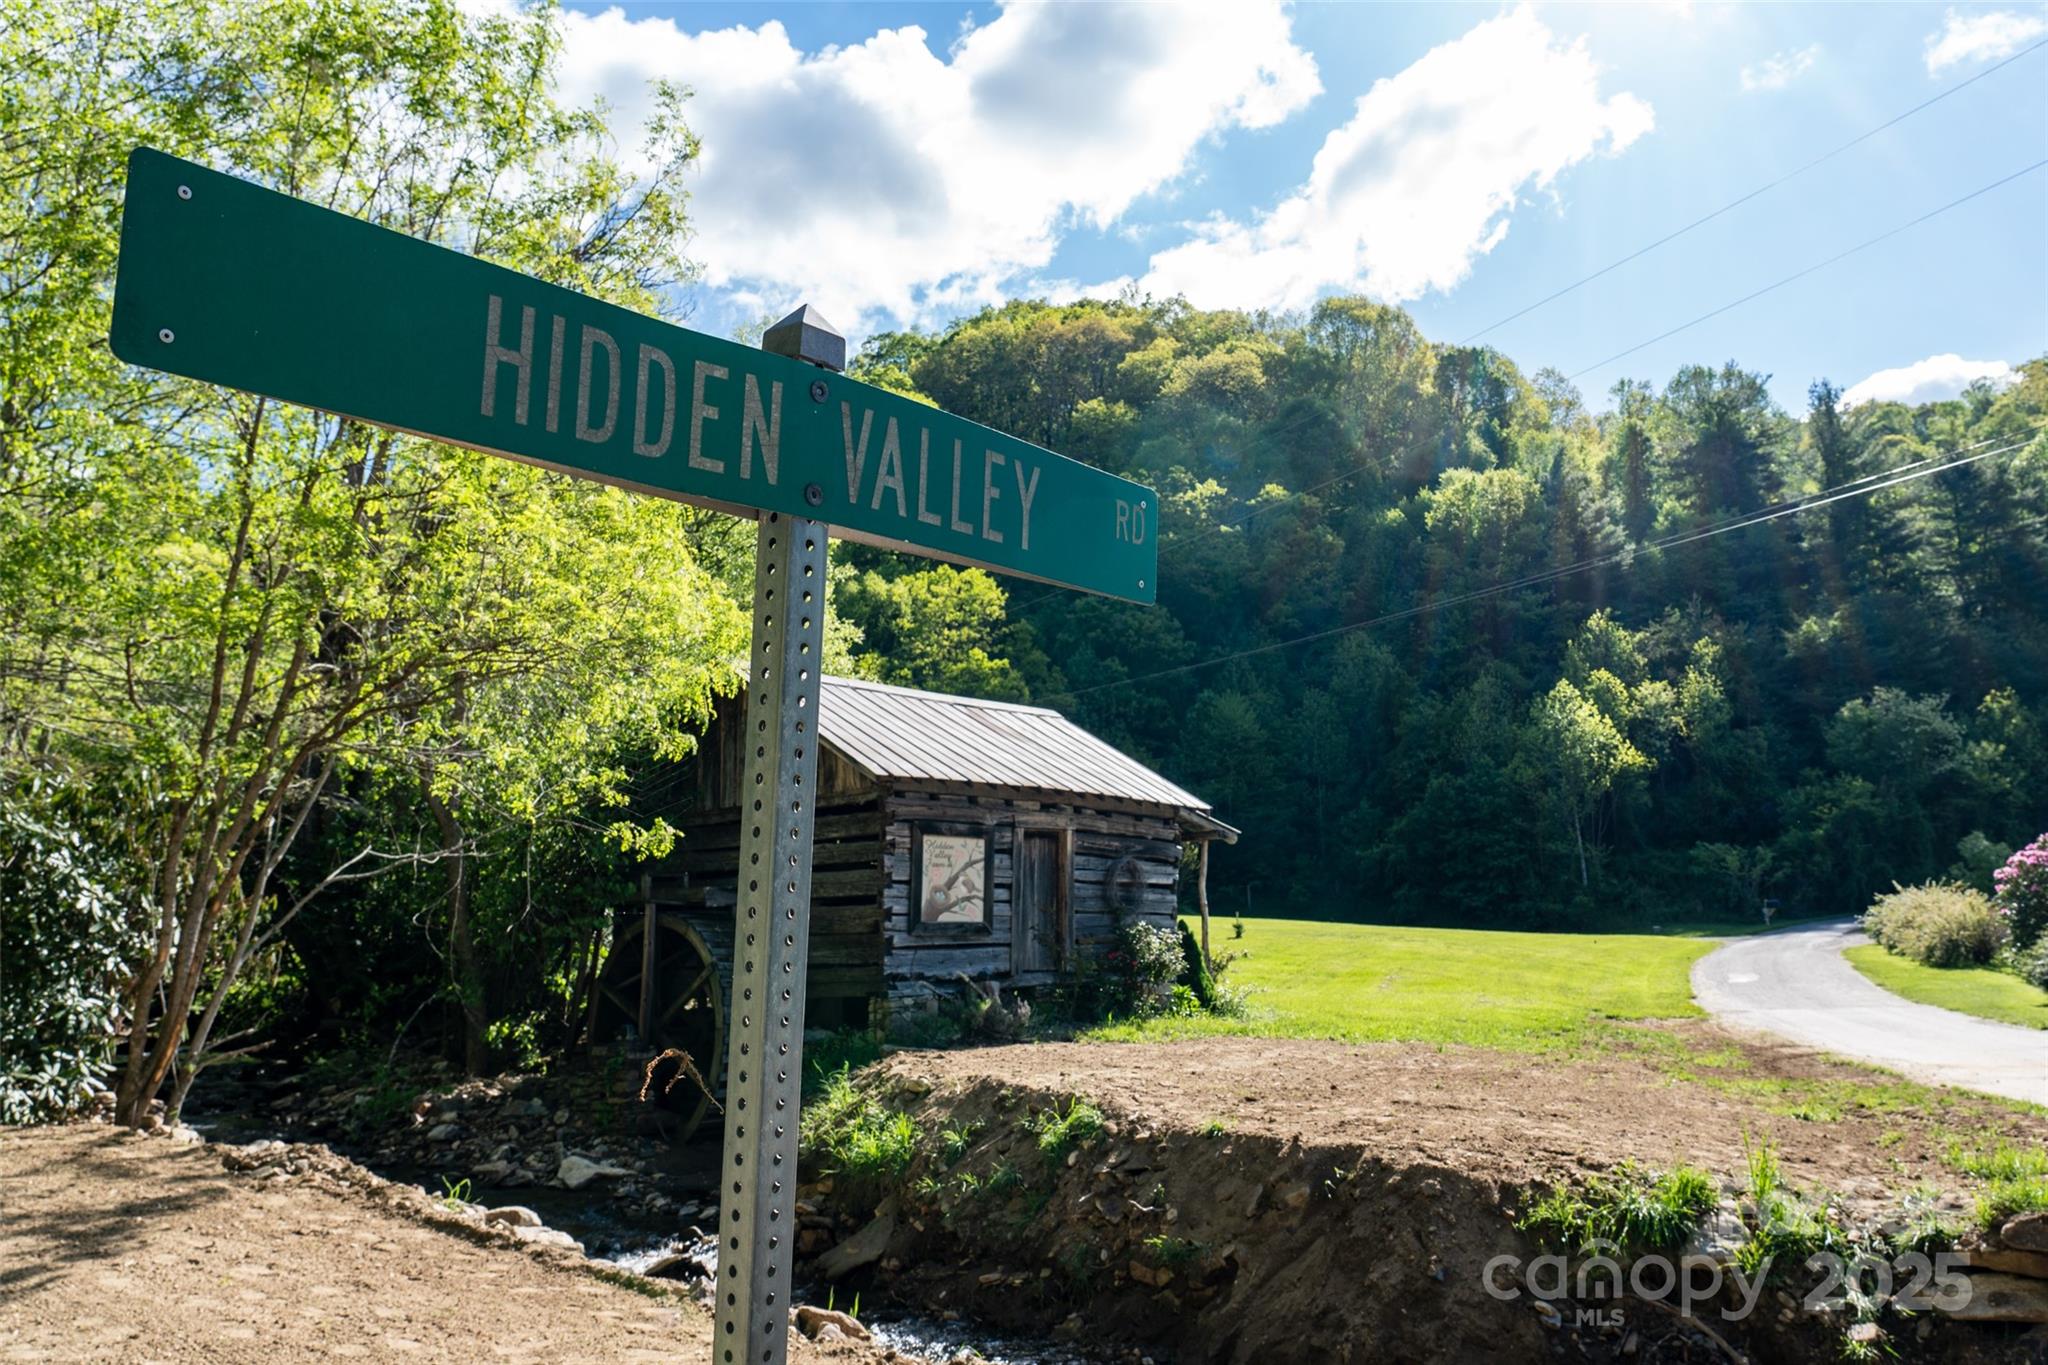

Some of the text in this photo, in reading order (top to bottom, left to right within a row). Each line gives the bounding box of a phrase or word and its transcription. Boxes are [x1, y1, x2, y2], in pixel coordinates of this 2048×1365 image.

[480, 294, 1146, 550] HIDDEN VALLEY RD
